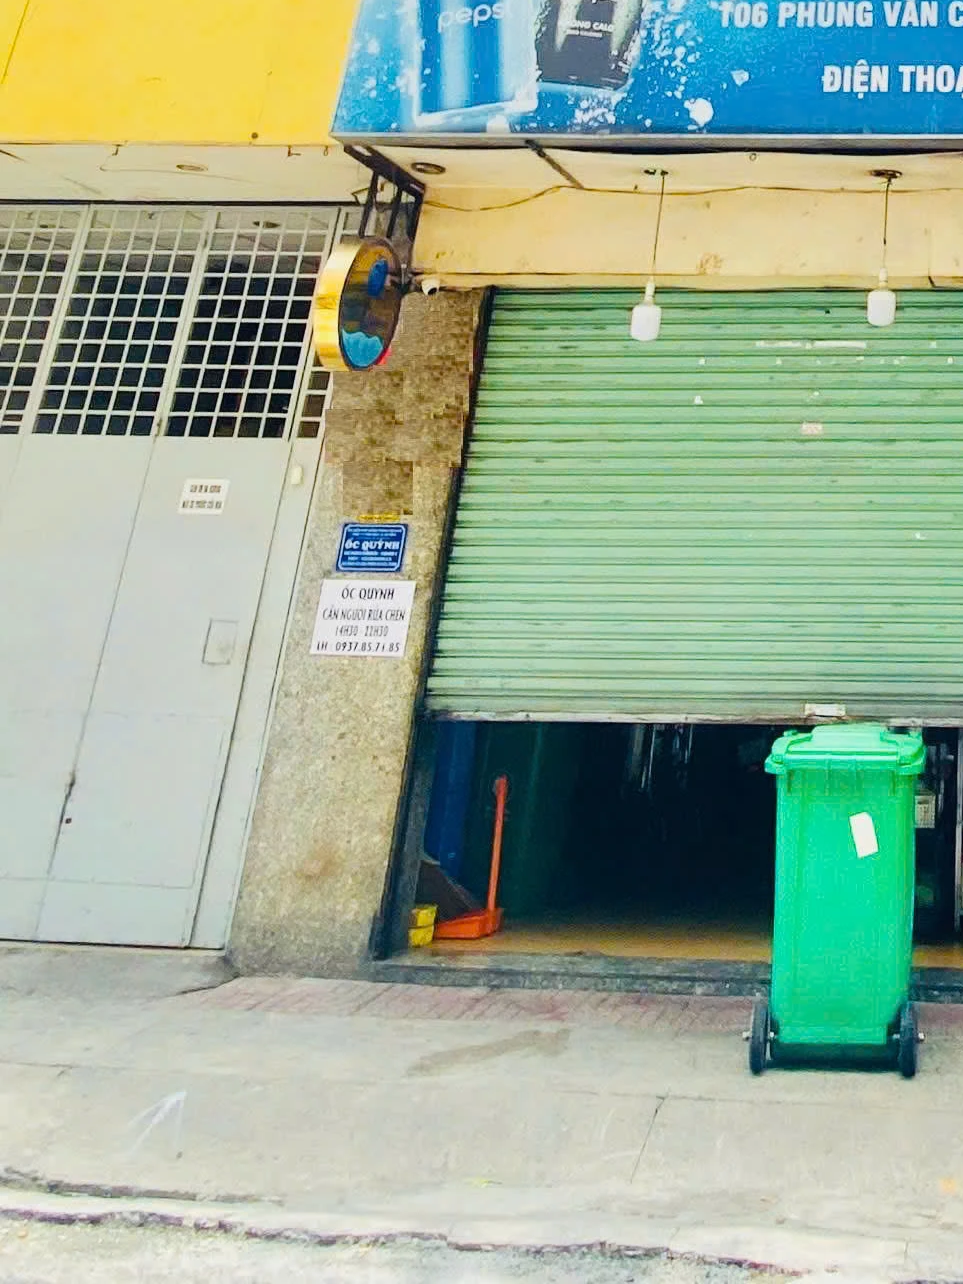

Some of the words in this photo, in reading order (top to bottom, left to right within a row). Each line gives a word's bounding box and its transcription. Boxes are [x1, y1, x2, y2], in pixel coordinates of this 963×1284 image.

[438, 2, 511, 33] peps
[720, 1, 768, 28] 106
[822, 59, 889, 99] ĐIỆN
